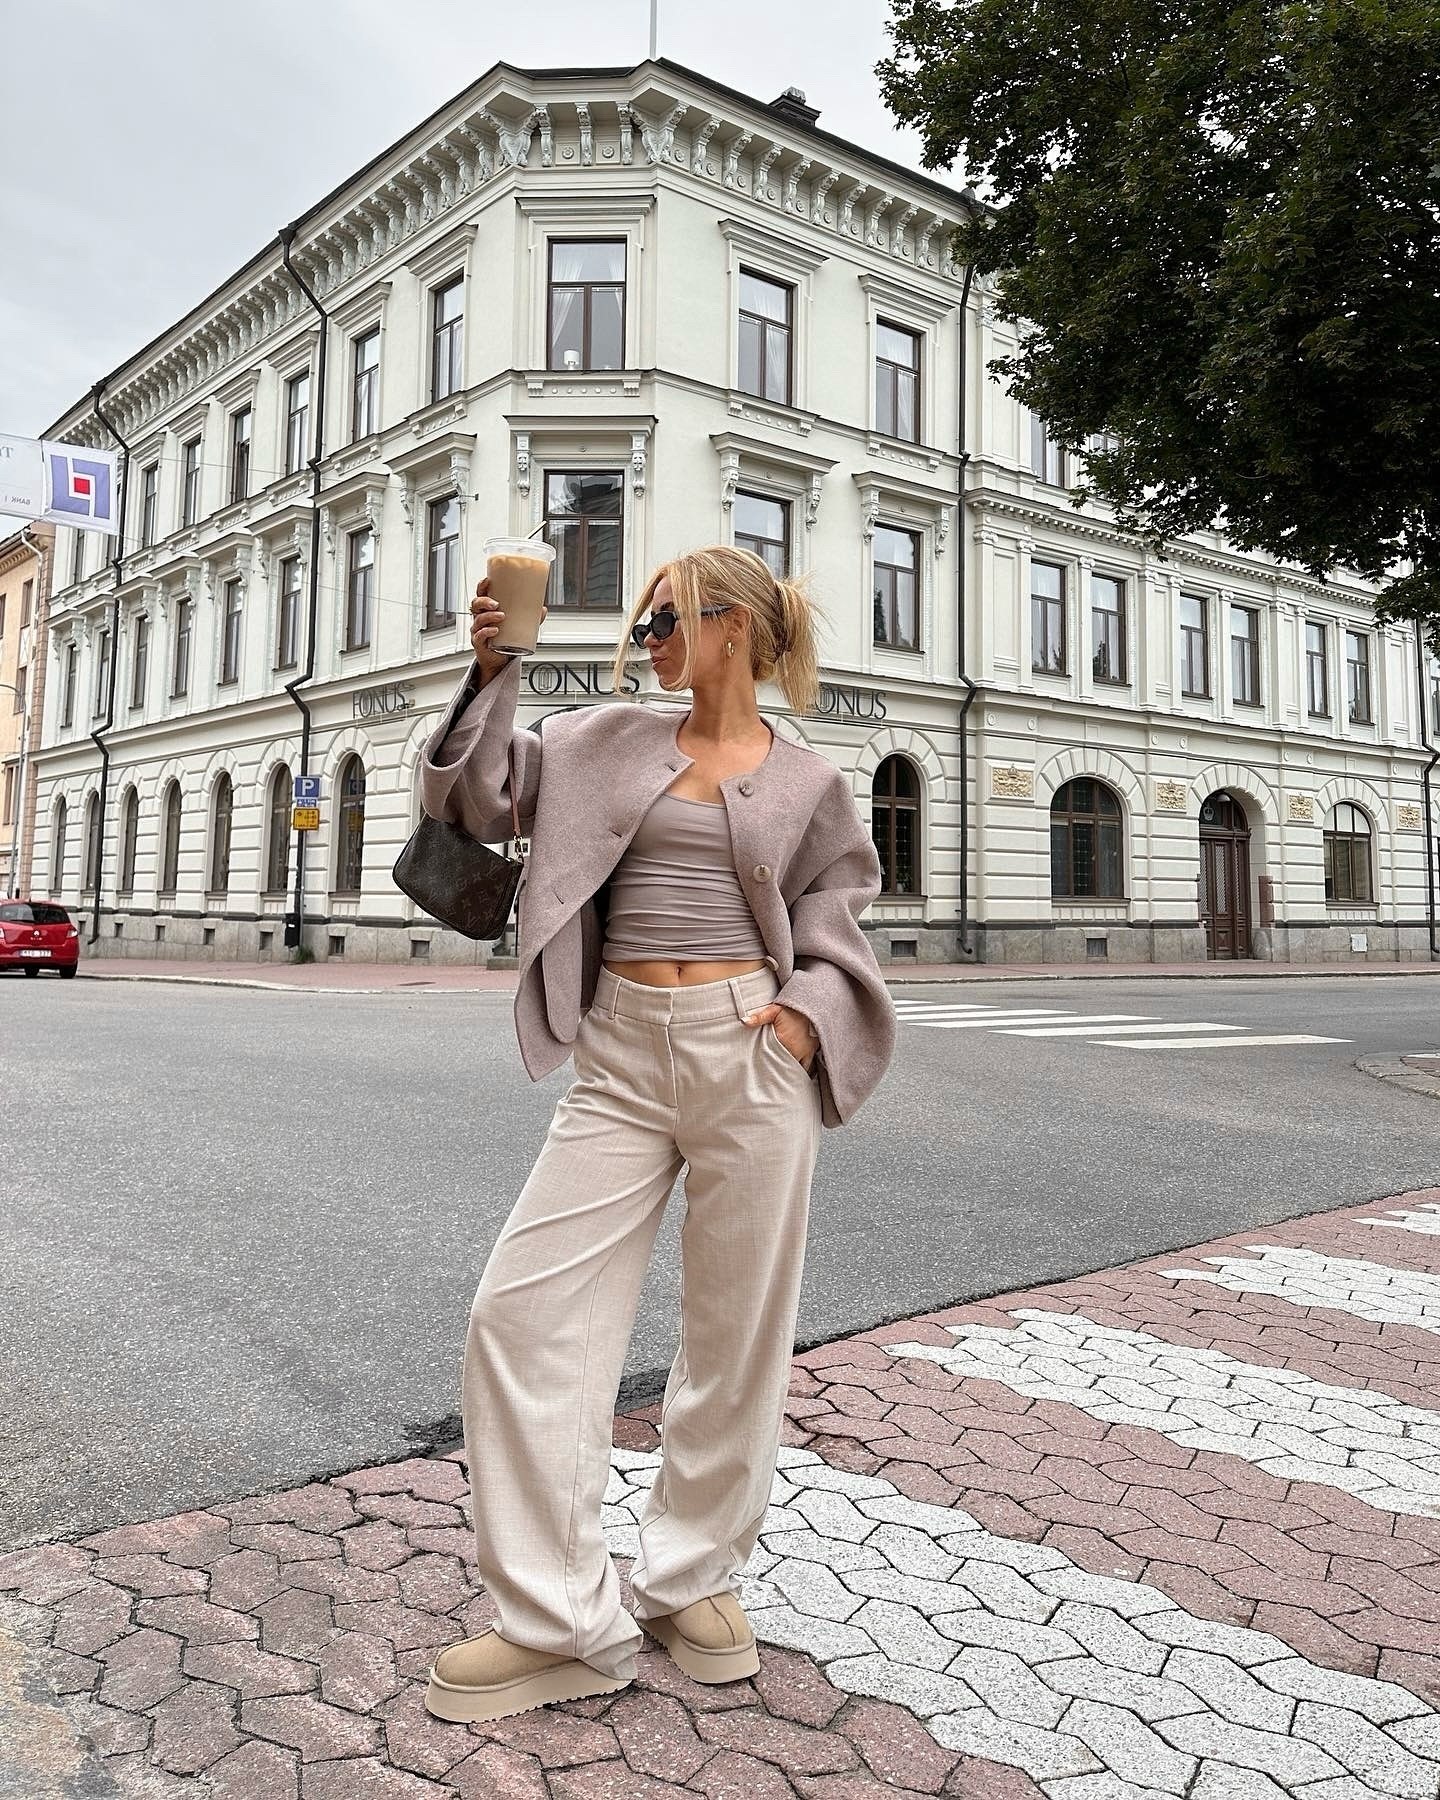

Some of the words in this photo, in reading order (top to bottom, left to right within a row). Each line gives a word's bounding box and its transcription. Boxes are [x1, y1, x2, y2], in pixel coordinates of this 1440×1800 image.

[520, 663, 640, 695] ONUS
[352, 682, 406, 718] FONUS
[815, 686, 887, 719] ONUS
[302, 779, 314, 796] P
